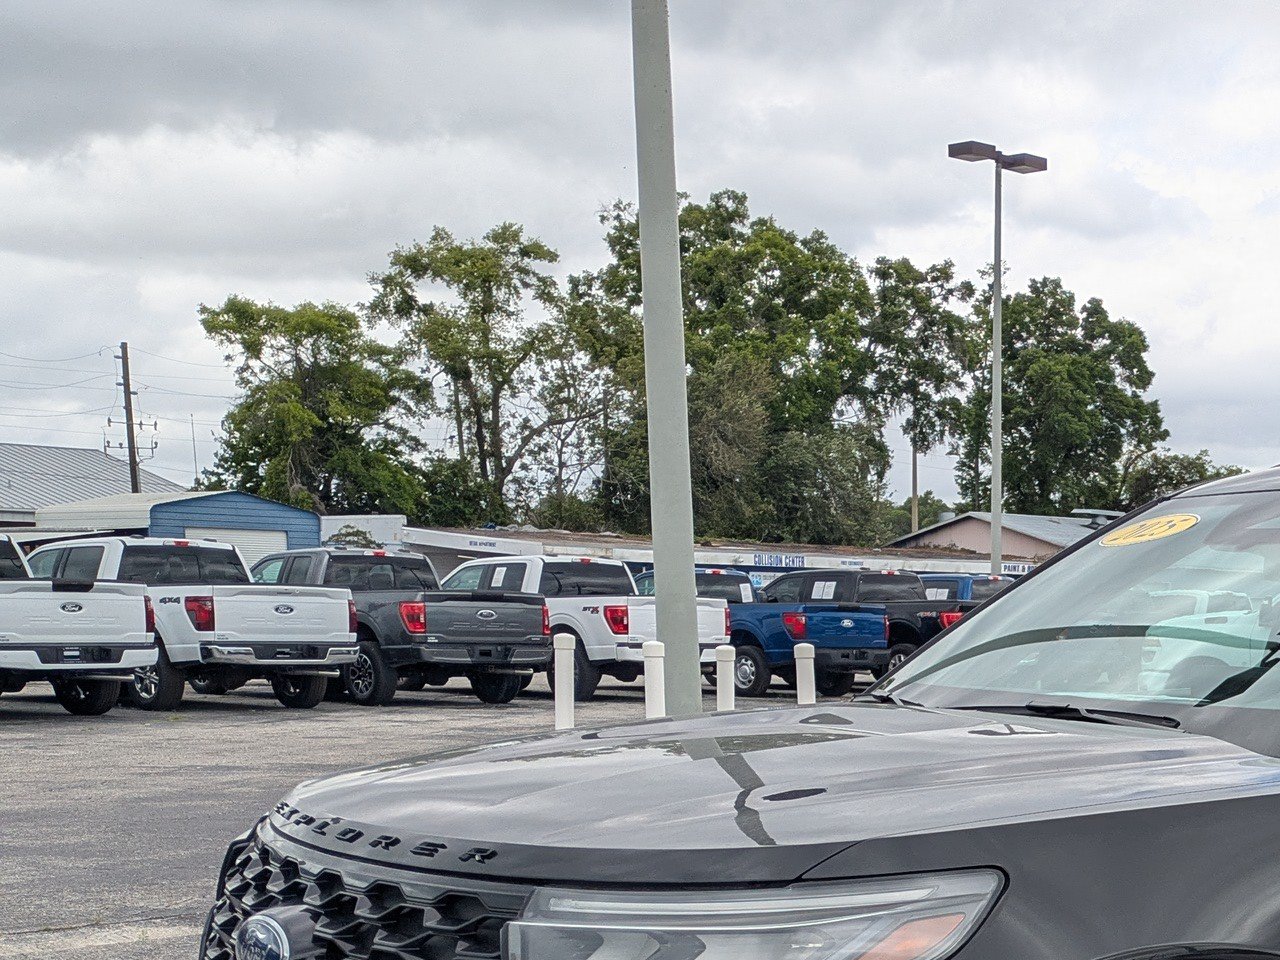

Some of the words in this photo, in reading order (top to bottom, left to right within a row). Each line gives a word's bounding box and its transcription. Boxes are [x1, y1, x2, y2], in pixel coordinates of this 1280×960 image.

[753, 554, 782, 567] COLLISION
[784, 556, 805, 567] CENTER
[1003, 564, 1020, 572] PAINT
[273, 800, 499, 864] EXPLORER
